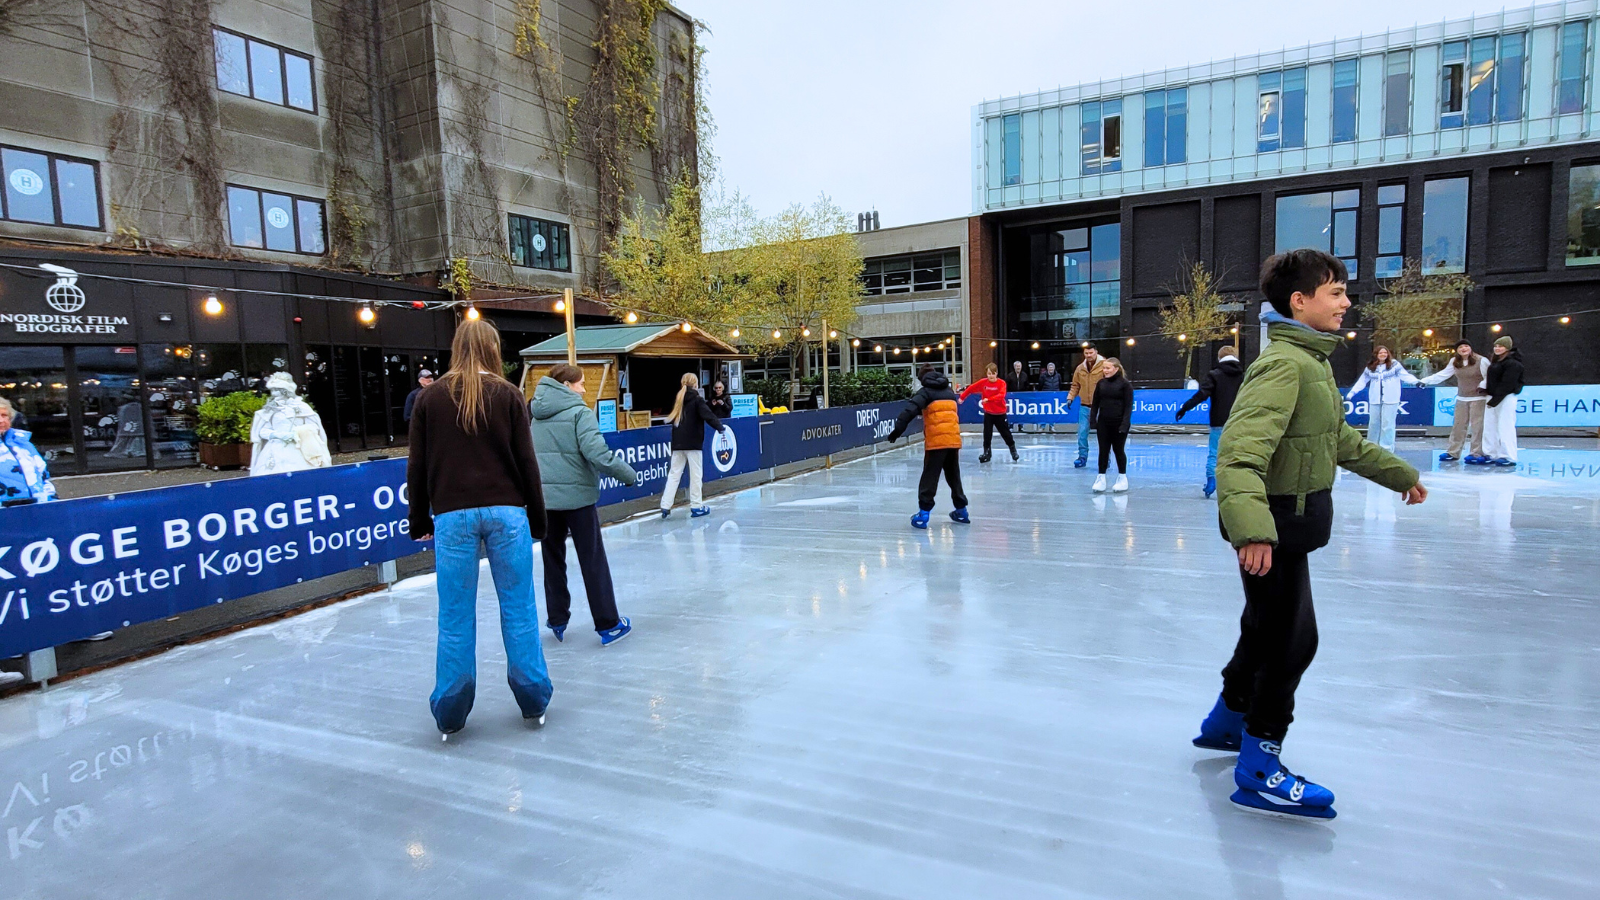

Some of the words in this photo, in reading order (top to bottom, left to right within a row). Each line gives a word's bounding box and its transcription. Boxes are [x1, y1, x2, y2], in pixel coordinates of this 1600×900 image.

[0, 313, 83, 324] NORDISK
[87, 315, 129, 325] FILM
[15, 323, 117, 334] BIOGRAFER
[1141, 400, 1163, 412] kan
[1165, 401, 1177, 412] vi
[1515, 399, 1543, 413] GE
[801, 424, 842, 441] ADVOKATER
[610, 441, 672, 464] ORENIN
[163, 494, 356, 549] BORGER-
[48, 563, 186, 613] støtter
[198, 541, 299, 580] Køges
[308, 518, 410, 554] borgere
